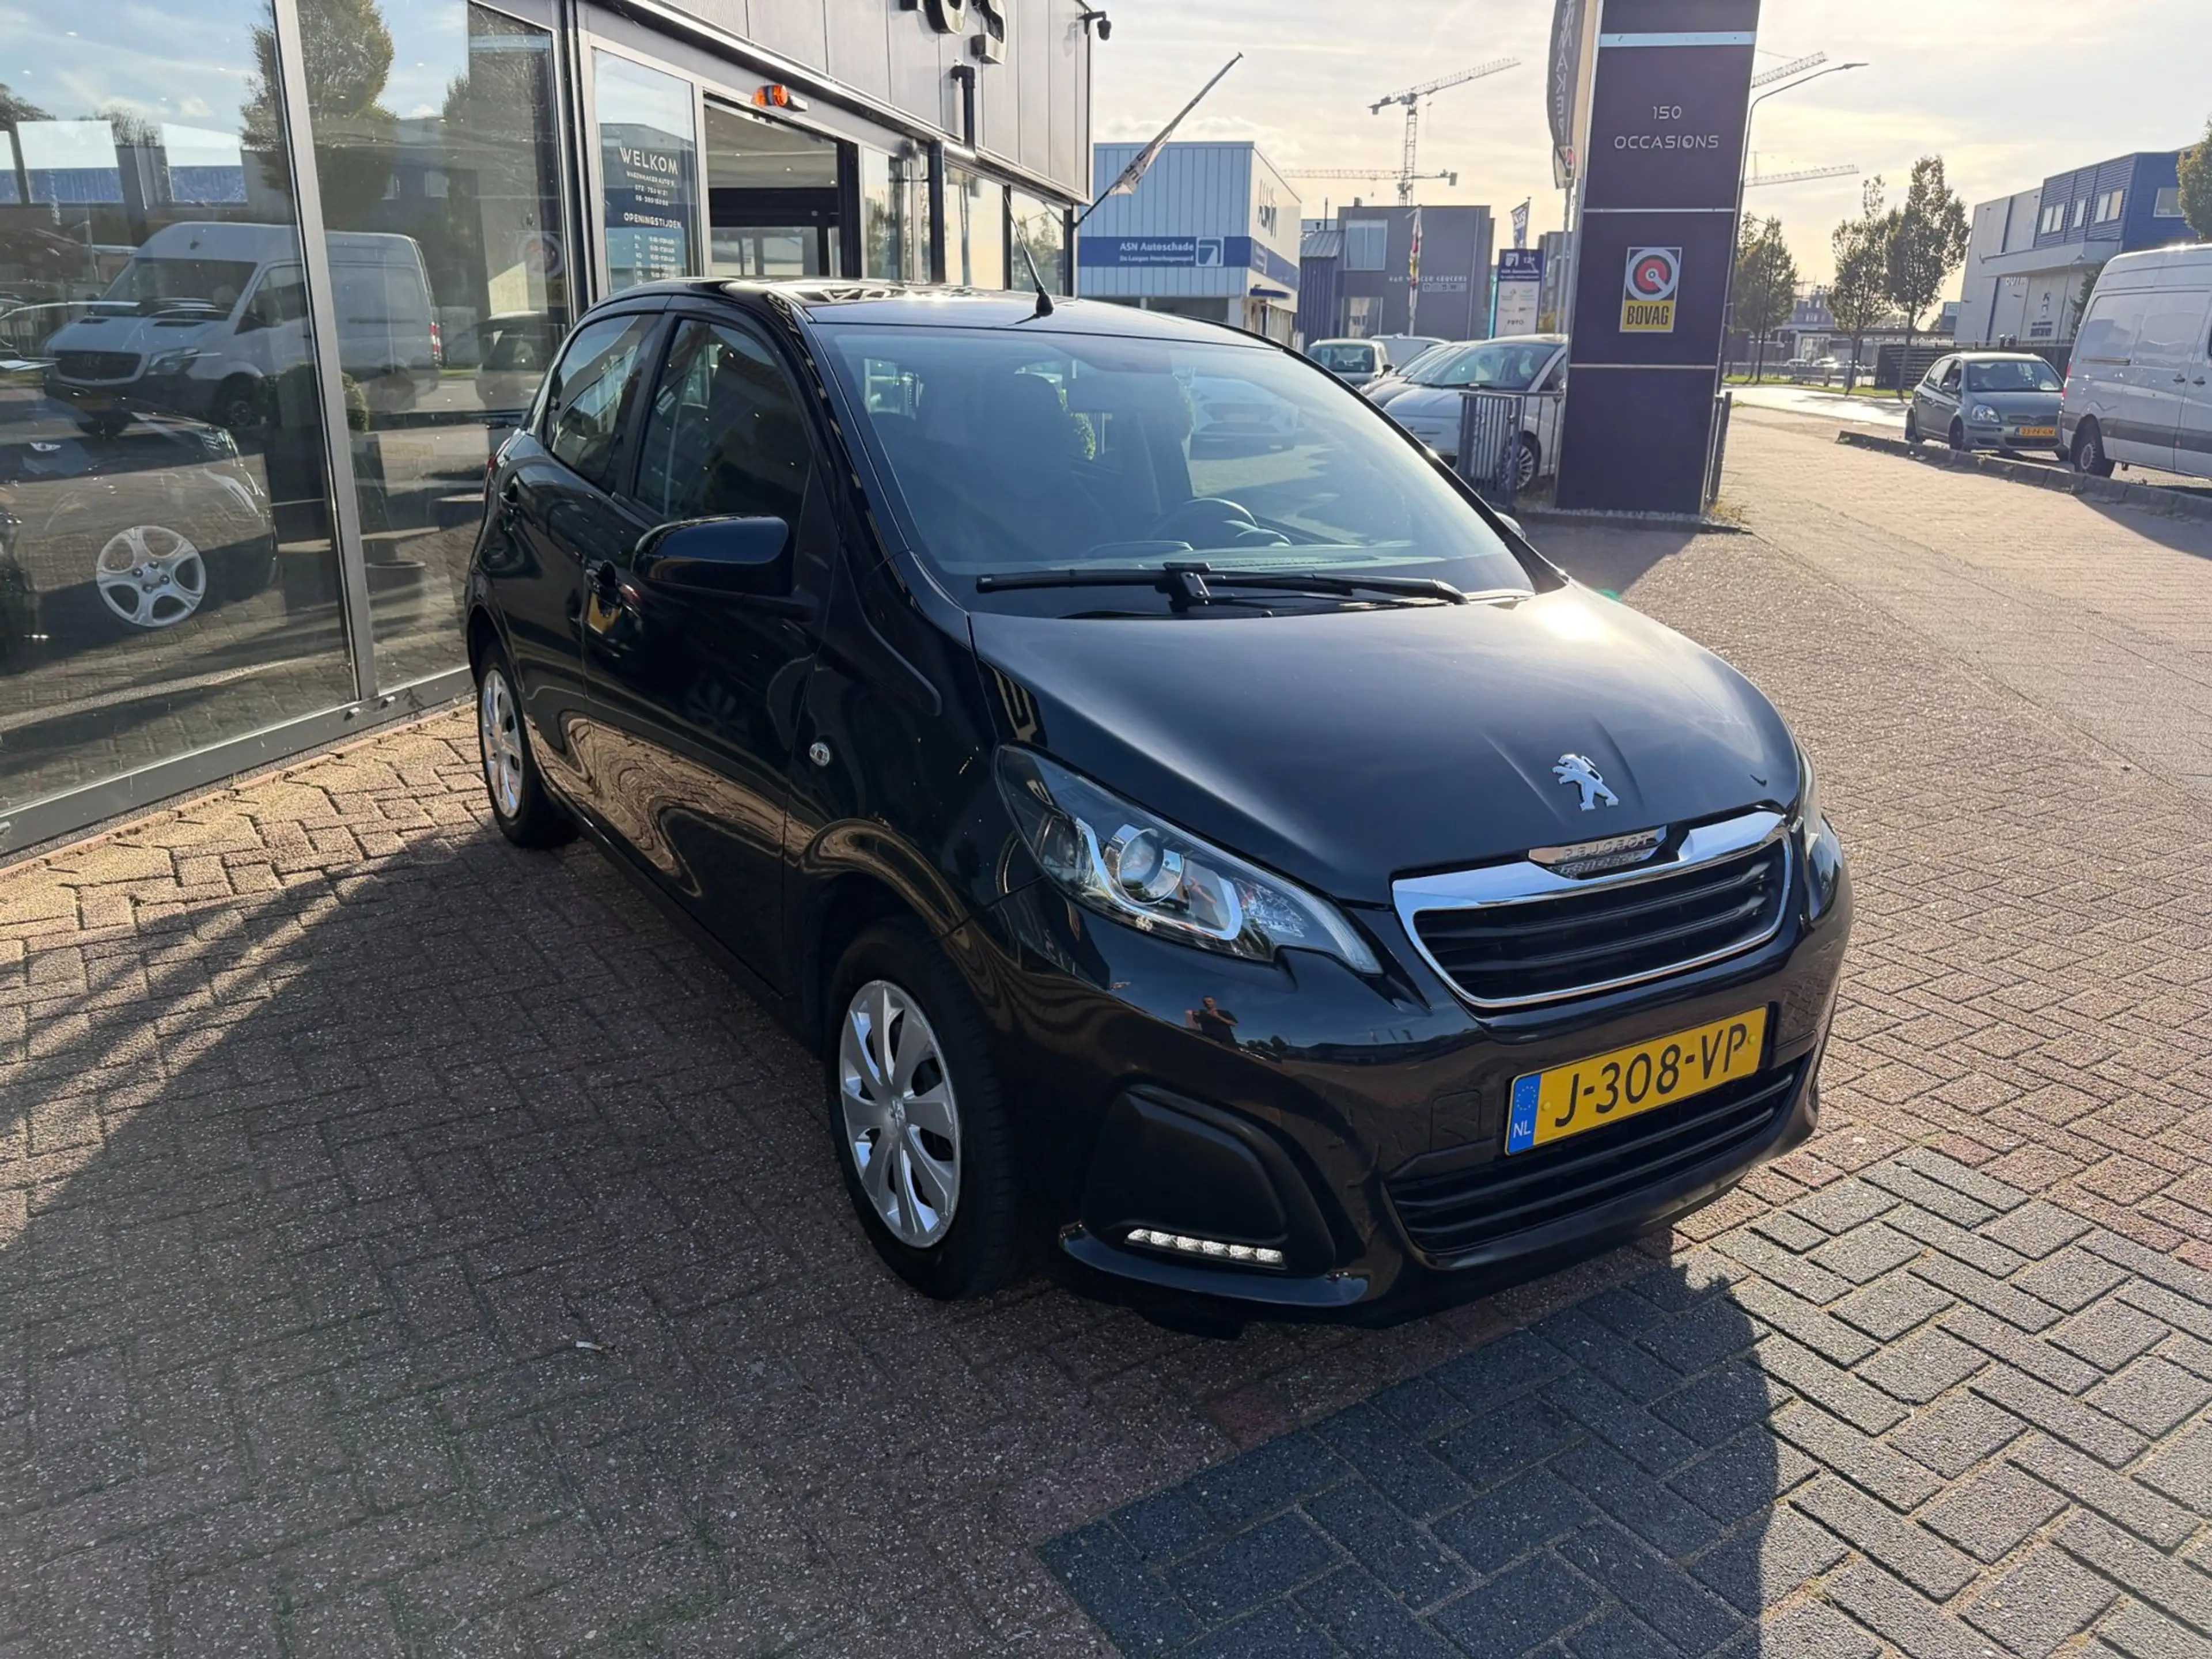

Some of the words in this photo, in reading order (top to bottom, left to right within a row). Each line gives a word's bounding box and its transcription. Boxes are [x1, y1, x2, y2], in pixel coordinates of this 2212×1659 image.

[1653, 105, 1682, 120] 150
[1614, 135, 1719, 149] OCCASIONS
[619, 146, 679, 176] WELKOM
[623, 211, 681, 229] OPENINGSTIJDEN
[1120, 243, 1138, 252] ASN
[1140, 241, 1194, 252] Autoschade
[1627, 305, 1669, 325] BOVAG
[1563, 835, 1650, 860] PEUGEOT
[1555, 1023, 1748, 1127] J-308-VP
[1513, 1120, 1532, 1139] NL
